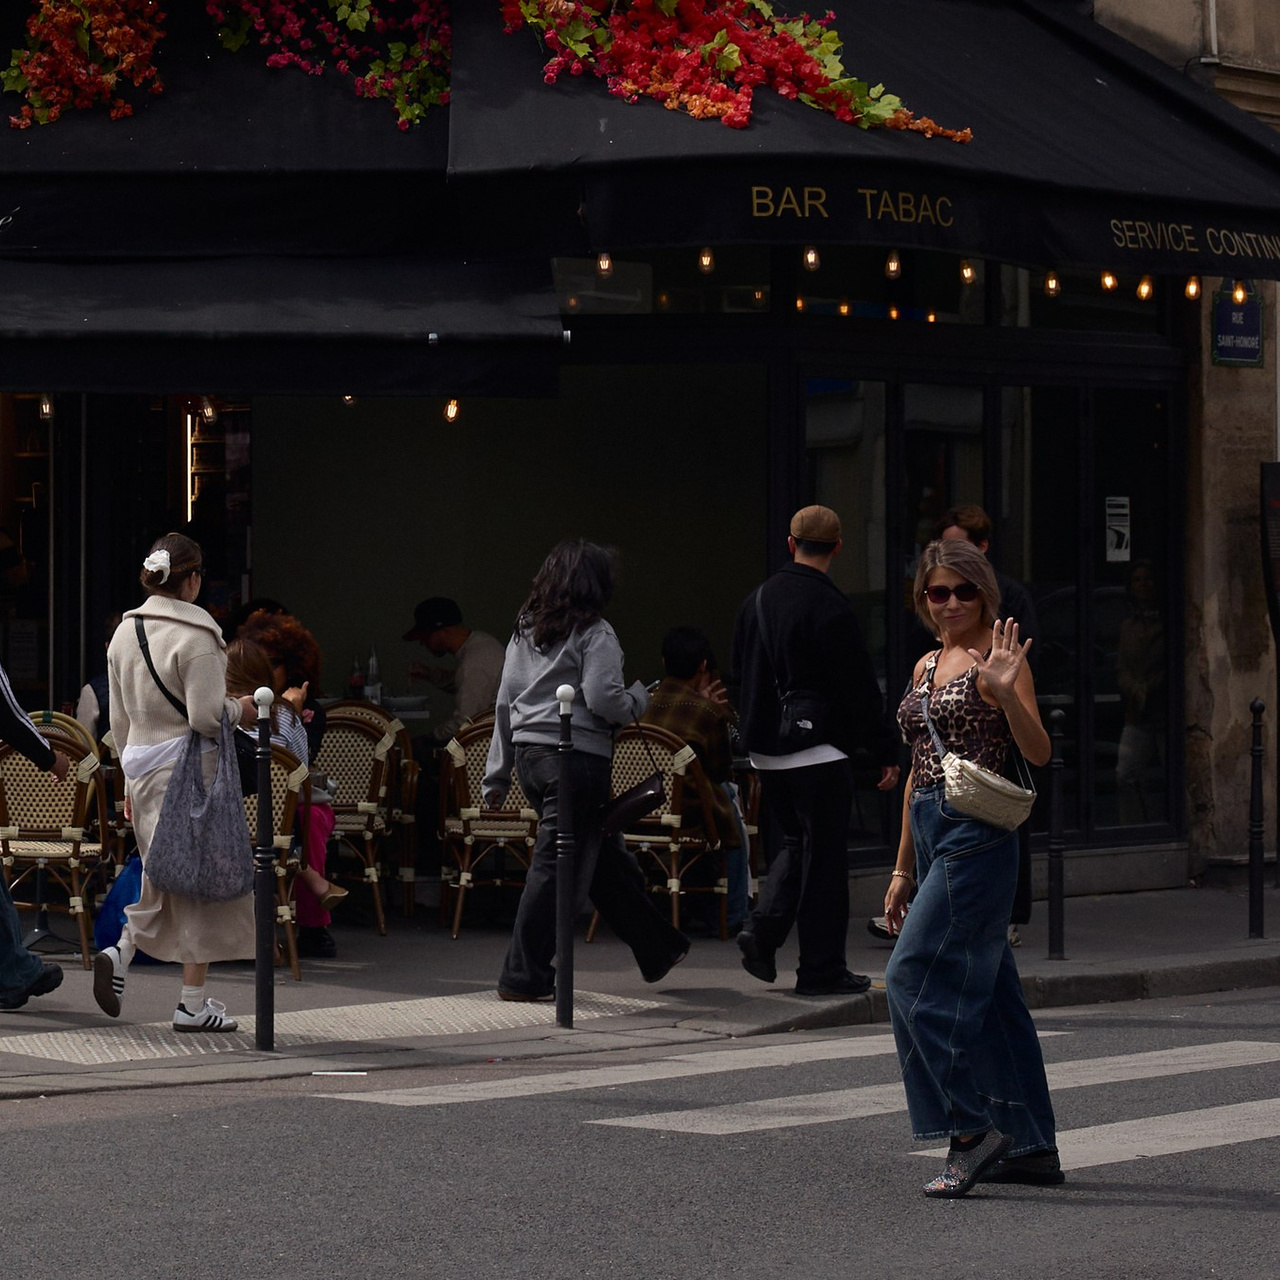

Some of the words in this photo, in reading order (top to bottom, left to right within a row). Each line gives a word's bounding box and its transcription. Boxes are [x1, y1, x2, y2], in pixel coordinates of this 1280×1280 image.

[751, 185, 830, 219] BAR
[857, 187, 955, 228] TABAC
[1110, 219, 1200, 253] SERVICE
